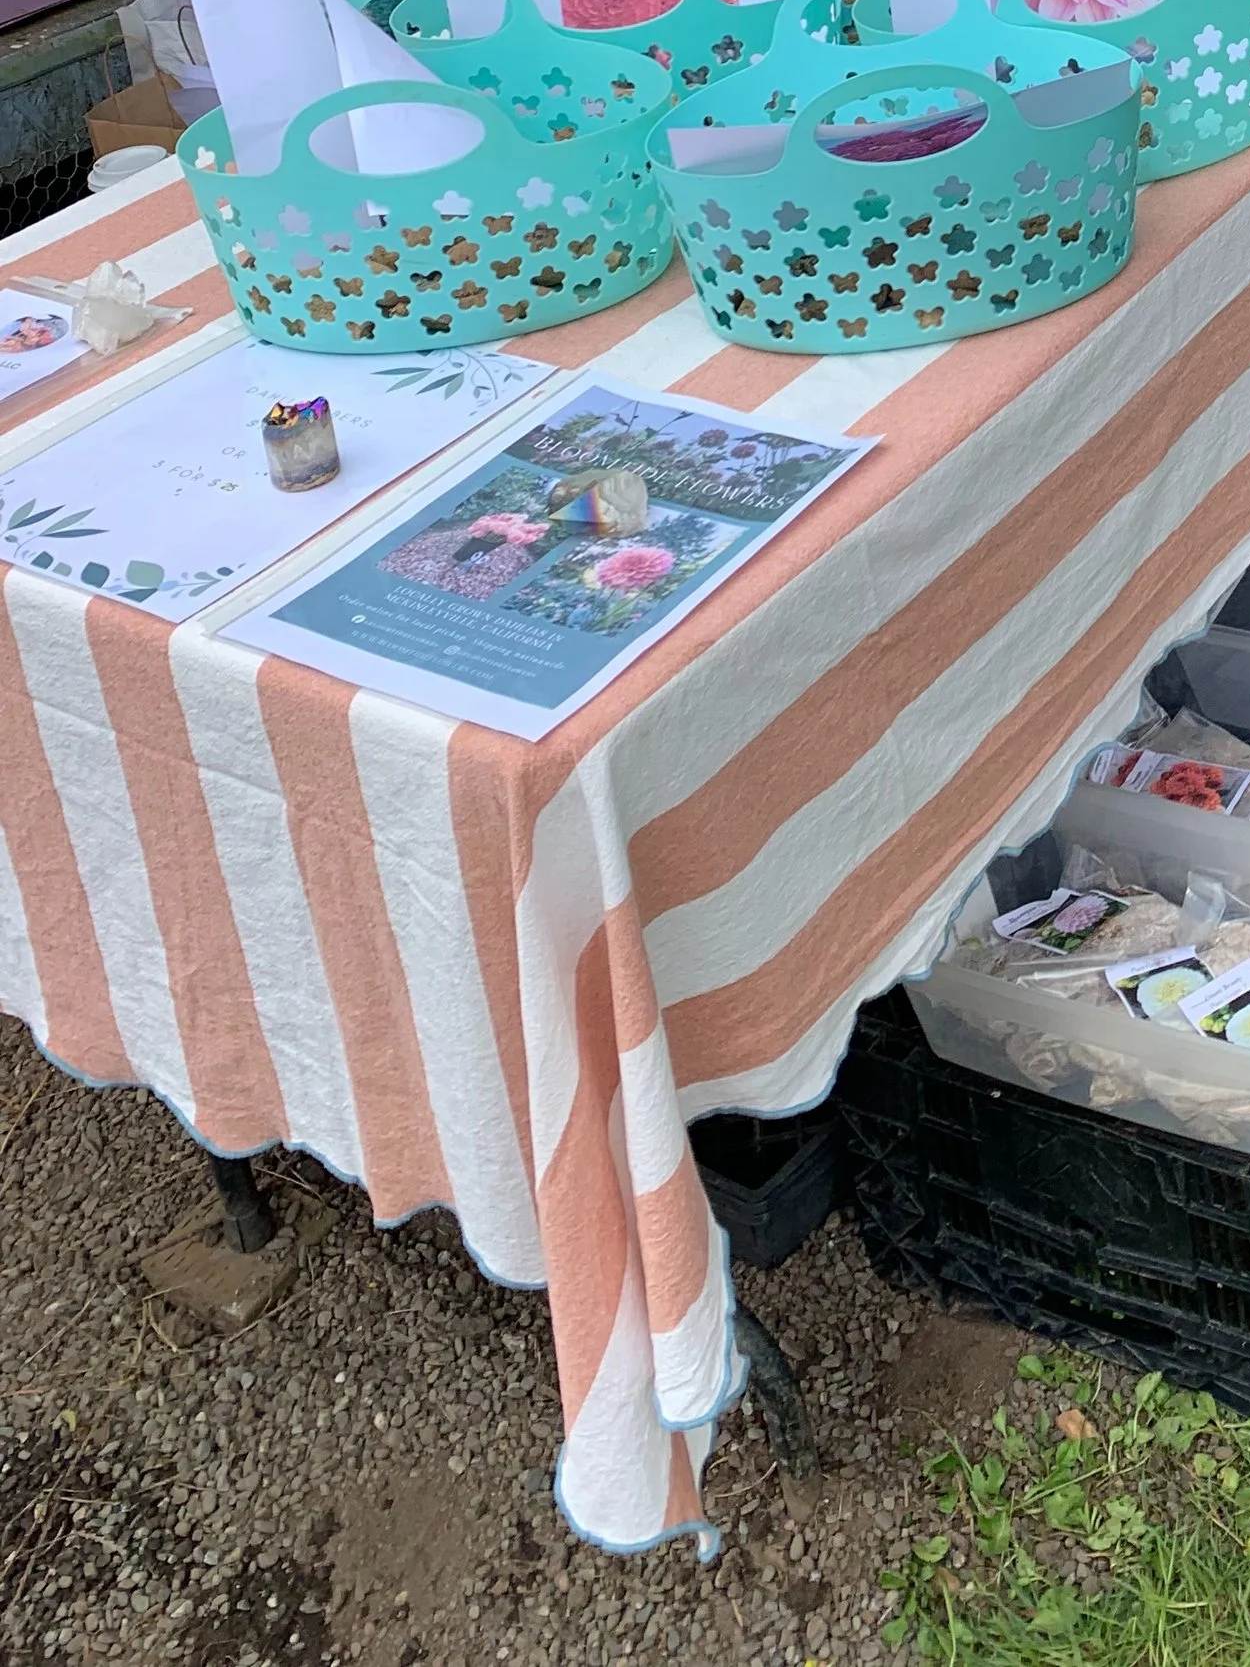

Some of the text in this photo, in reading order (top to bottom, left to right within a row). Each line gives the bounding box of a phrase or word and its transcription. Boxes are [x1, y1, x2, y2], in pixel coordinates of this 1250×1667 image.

[246, 385, 297, 405] DAHLI
[222, 446, 247, 460] OR
[168, 465, 205, 483] FOR
[674, 474, 791, 511] FLOWERS
[338, 594, 365, 607] Order
[393, 586, 565, 643] LOCALLY GROWN DAHLIAS IN
[480, 624, 554, 652] CALIFORNIA
